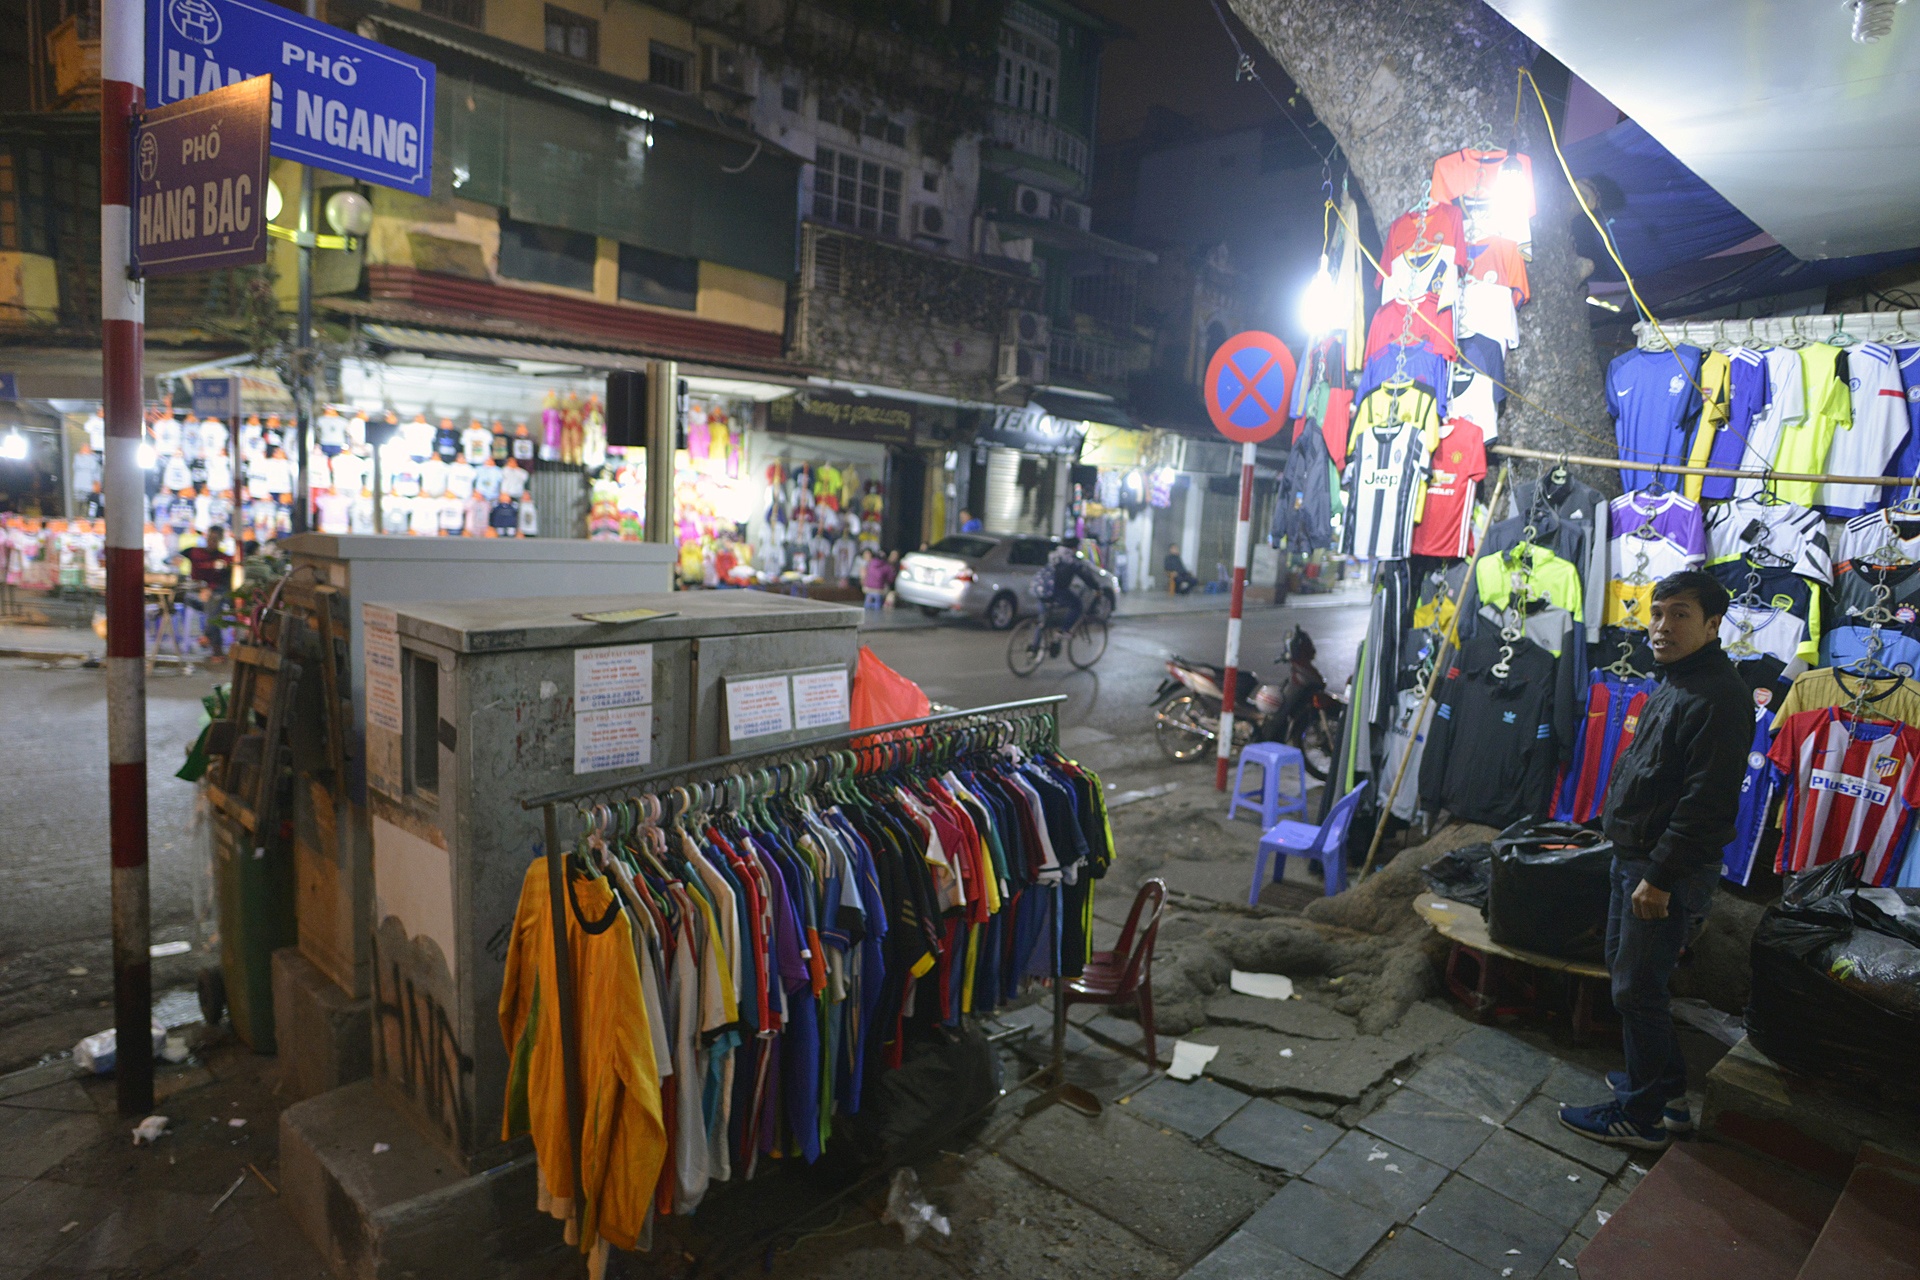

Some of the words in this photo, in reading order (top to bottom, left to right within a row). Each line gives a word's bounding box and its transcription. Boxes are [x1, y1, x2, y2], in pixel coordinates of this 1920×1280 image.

[281, 41, 362, 87] PHỐ
[181, 118, 223, 165] PHỐ
[296, 89, 417, 169] NGANG
[139, 180, 197, 247] HÀNG
[202, 173, 252, 246] BẠC
[1364, 471, 1398, 488] Jeep
[1811, 776, 1886, 803] Plus500
